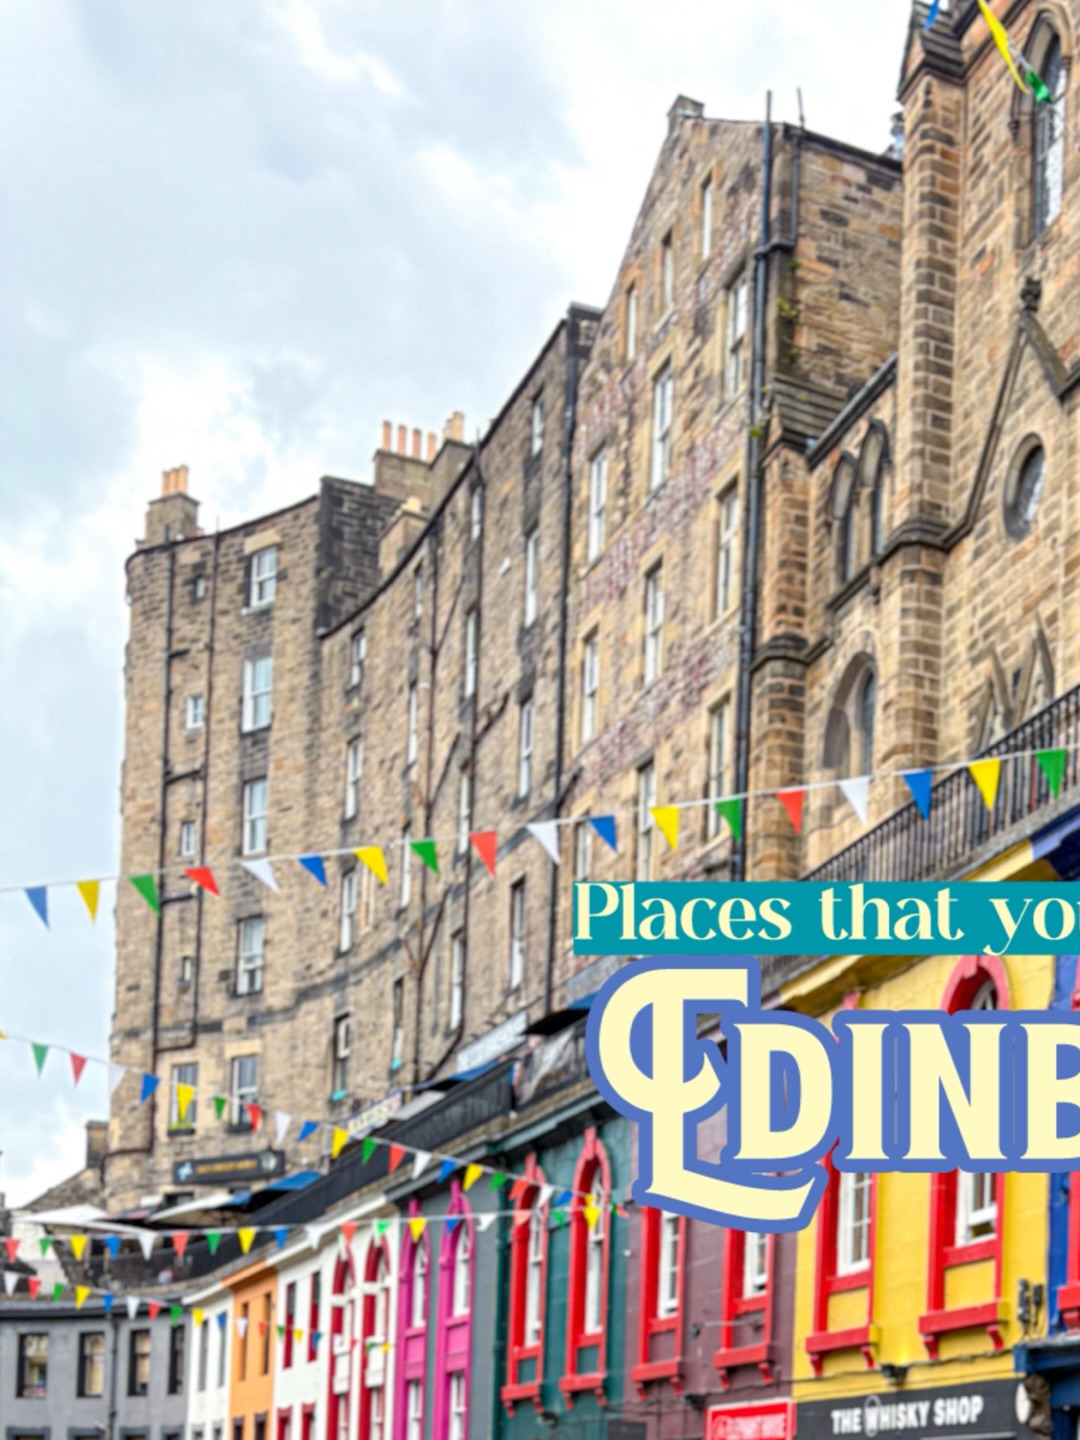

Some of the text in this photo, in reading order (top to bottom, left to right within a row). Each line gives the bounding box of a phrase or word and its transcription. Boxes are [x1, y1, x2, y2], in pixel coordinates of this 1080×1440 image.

[831, 1395, 984, 1435] THE WHISKY SHOP
